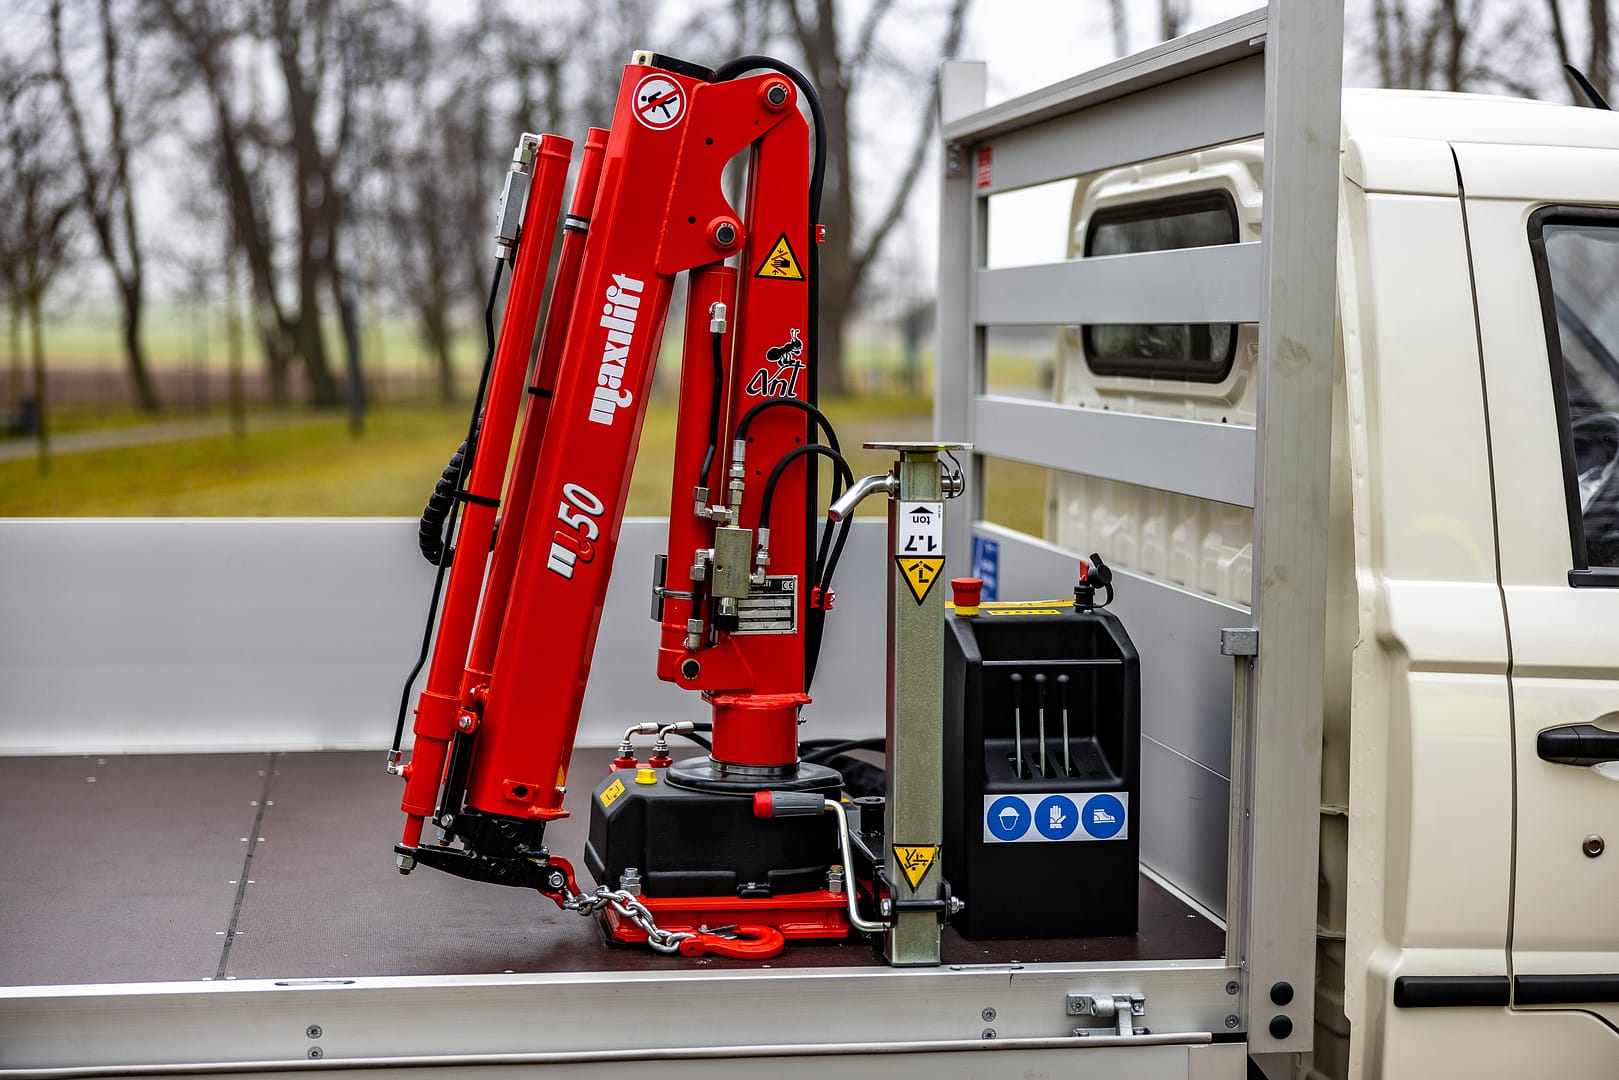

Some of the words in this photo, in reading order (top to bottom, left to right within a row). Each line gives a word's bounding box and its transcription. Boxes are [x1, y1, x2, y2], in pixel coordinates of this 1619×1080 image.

[588, 273, 645, 426] maxilift
[745, 360, 807, 398] Ant
[912, 515, 931, 526] ton
[904, 535, 938, 552] 1.7
